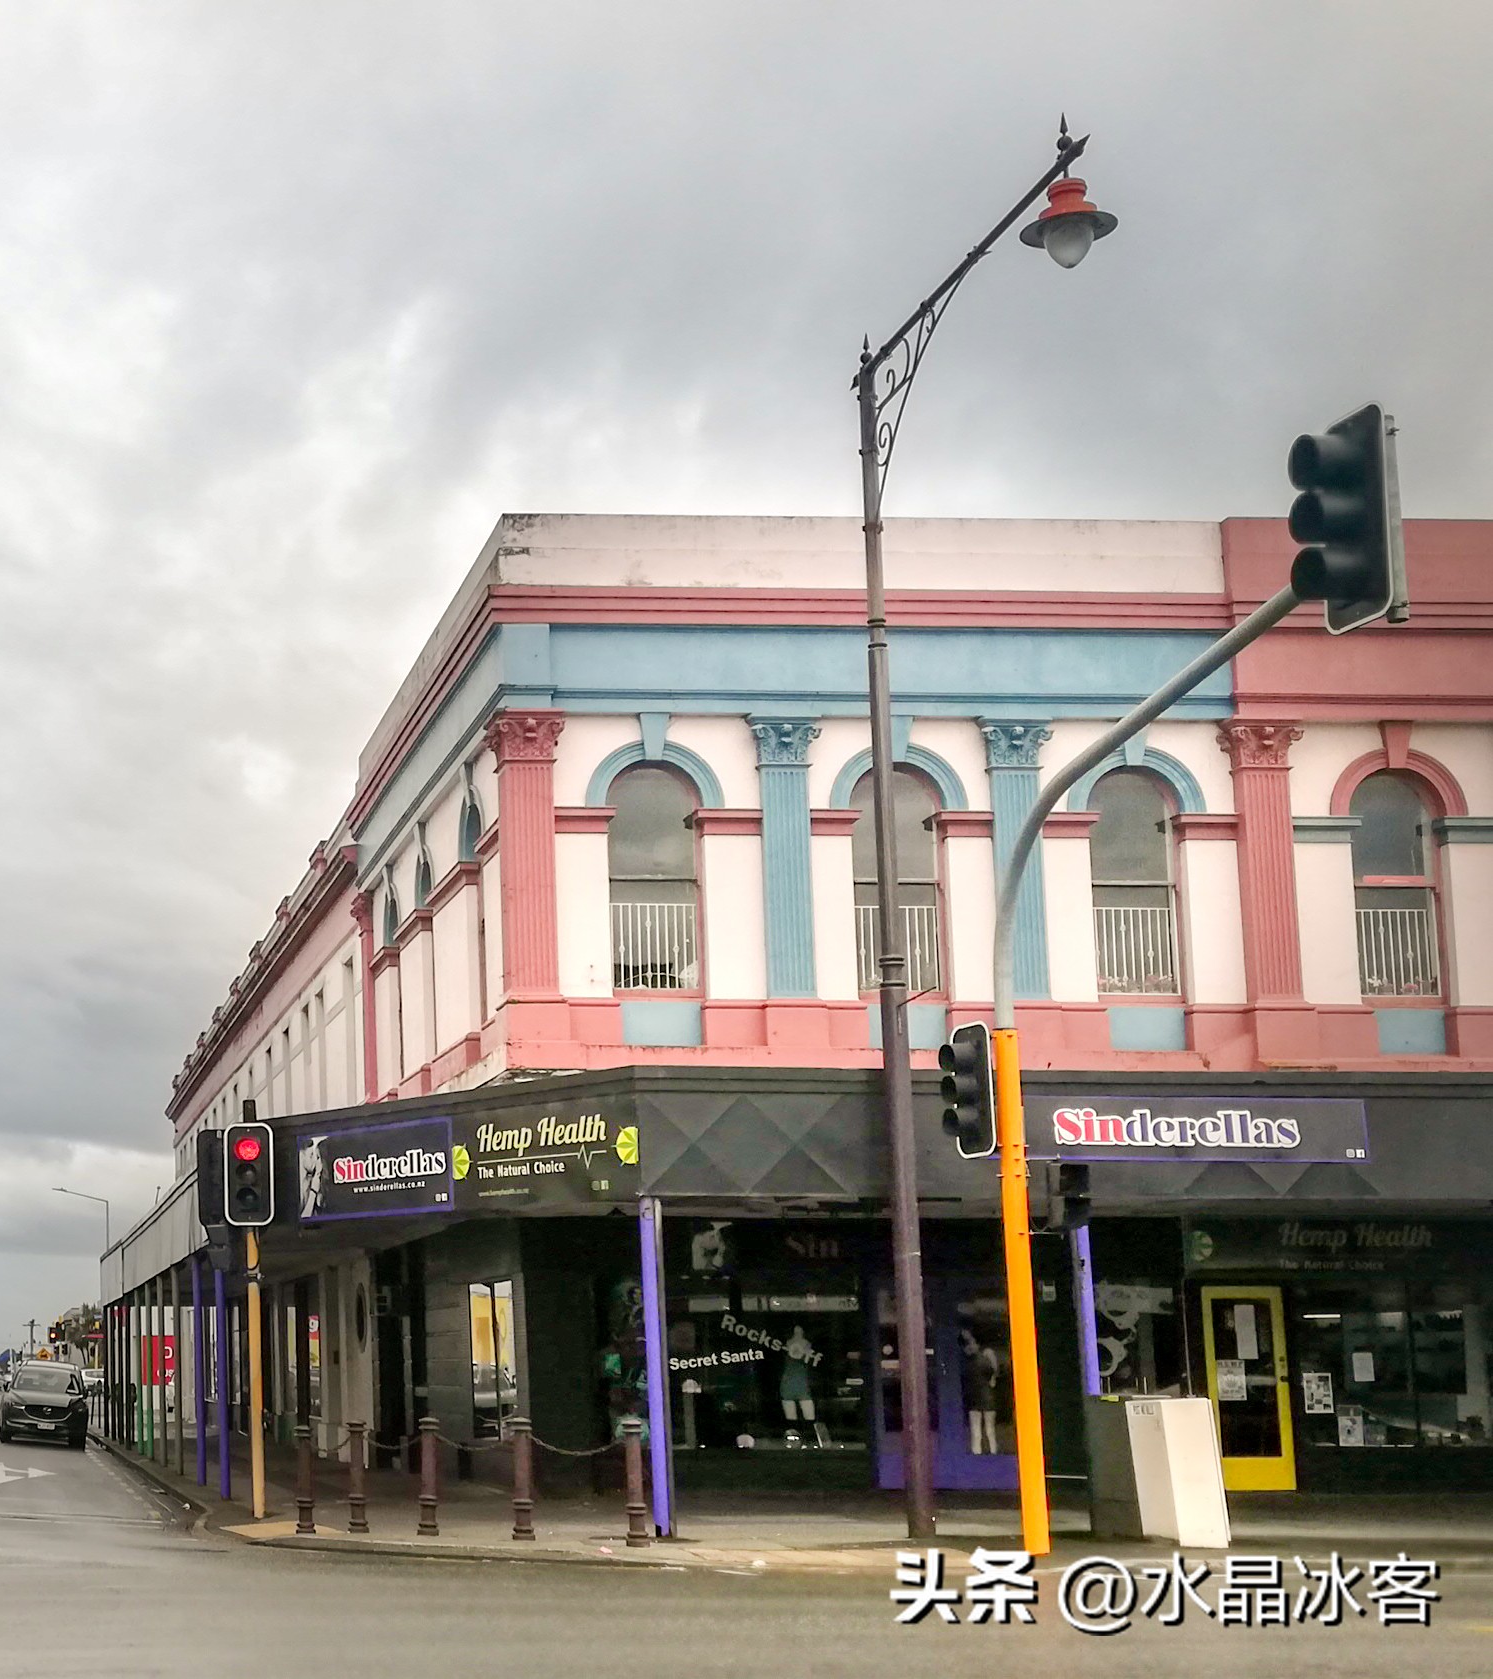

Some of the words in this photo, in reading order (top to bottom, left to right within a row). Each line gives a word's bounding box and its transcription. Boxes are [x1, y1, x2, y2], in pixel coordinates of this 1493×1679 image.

[476, 1123, 532, 1158] Hemp
[536, 1113, 607, 1147] Health
[1052, 1107, 1302, 1149] Sinderellas
[333, 1148, 447, 1185] Sinderellas
[477, 1166, 495, 1180] The
[497, 1163, 530, 1178] Natural
[534, 1160, 566, 1175] Choice
[669, 1353, 719, 1371] Secret
[721, 1348, 765, 1365] Santa
